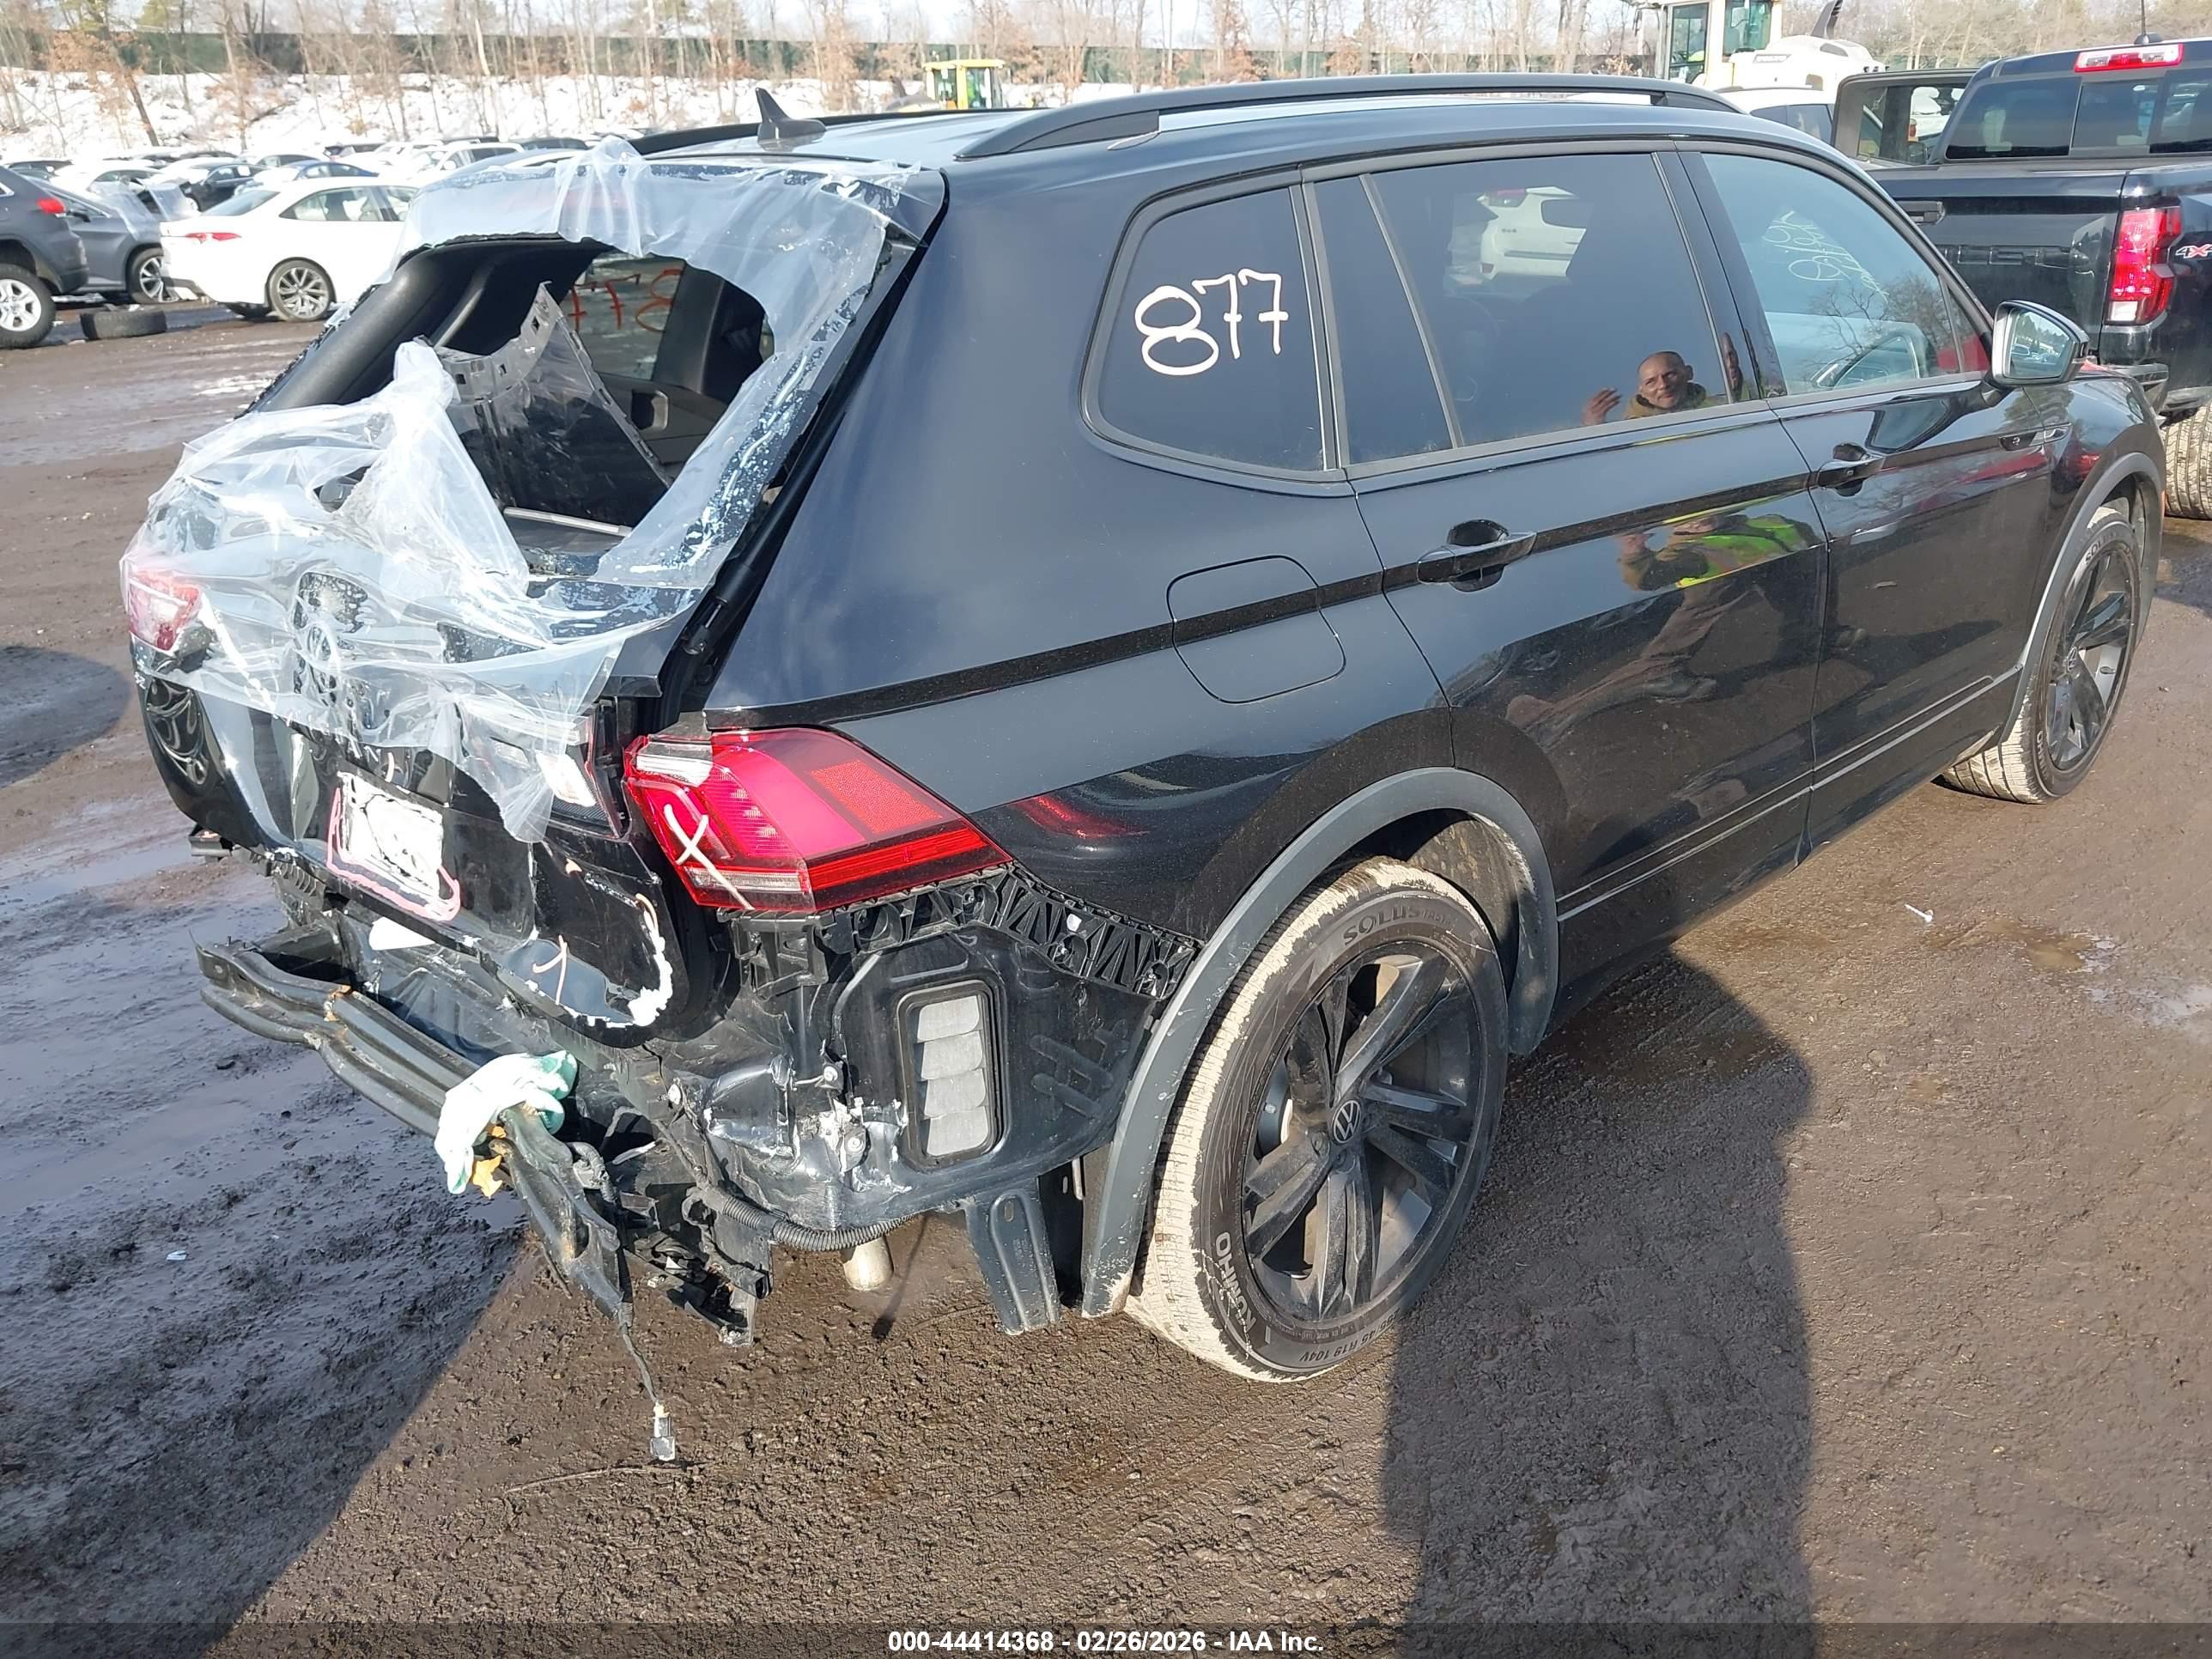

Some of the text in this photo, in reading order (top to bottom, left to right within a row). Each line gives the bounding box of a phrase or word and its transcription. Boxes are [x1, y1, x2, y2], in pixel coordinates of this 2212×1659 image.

[1134, 269, 1289, 375] 877
[1343, 905, 1420, 945] SOLUS
[1216, 1231, 1257, 1333] KUMHO
[1299, 1350, 1330, 1362] 104V
[1334, 1340, 1358, 1358] R19
